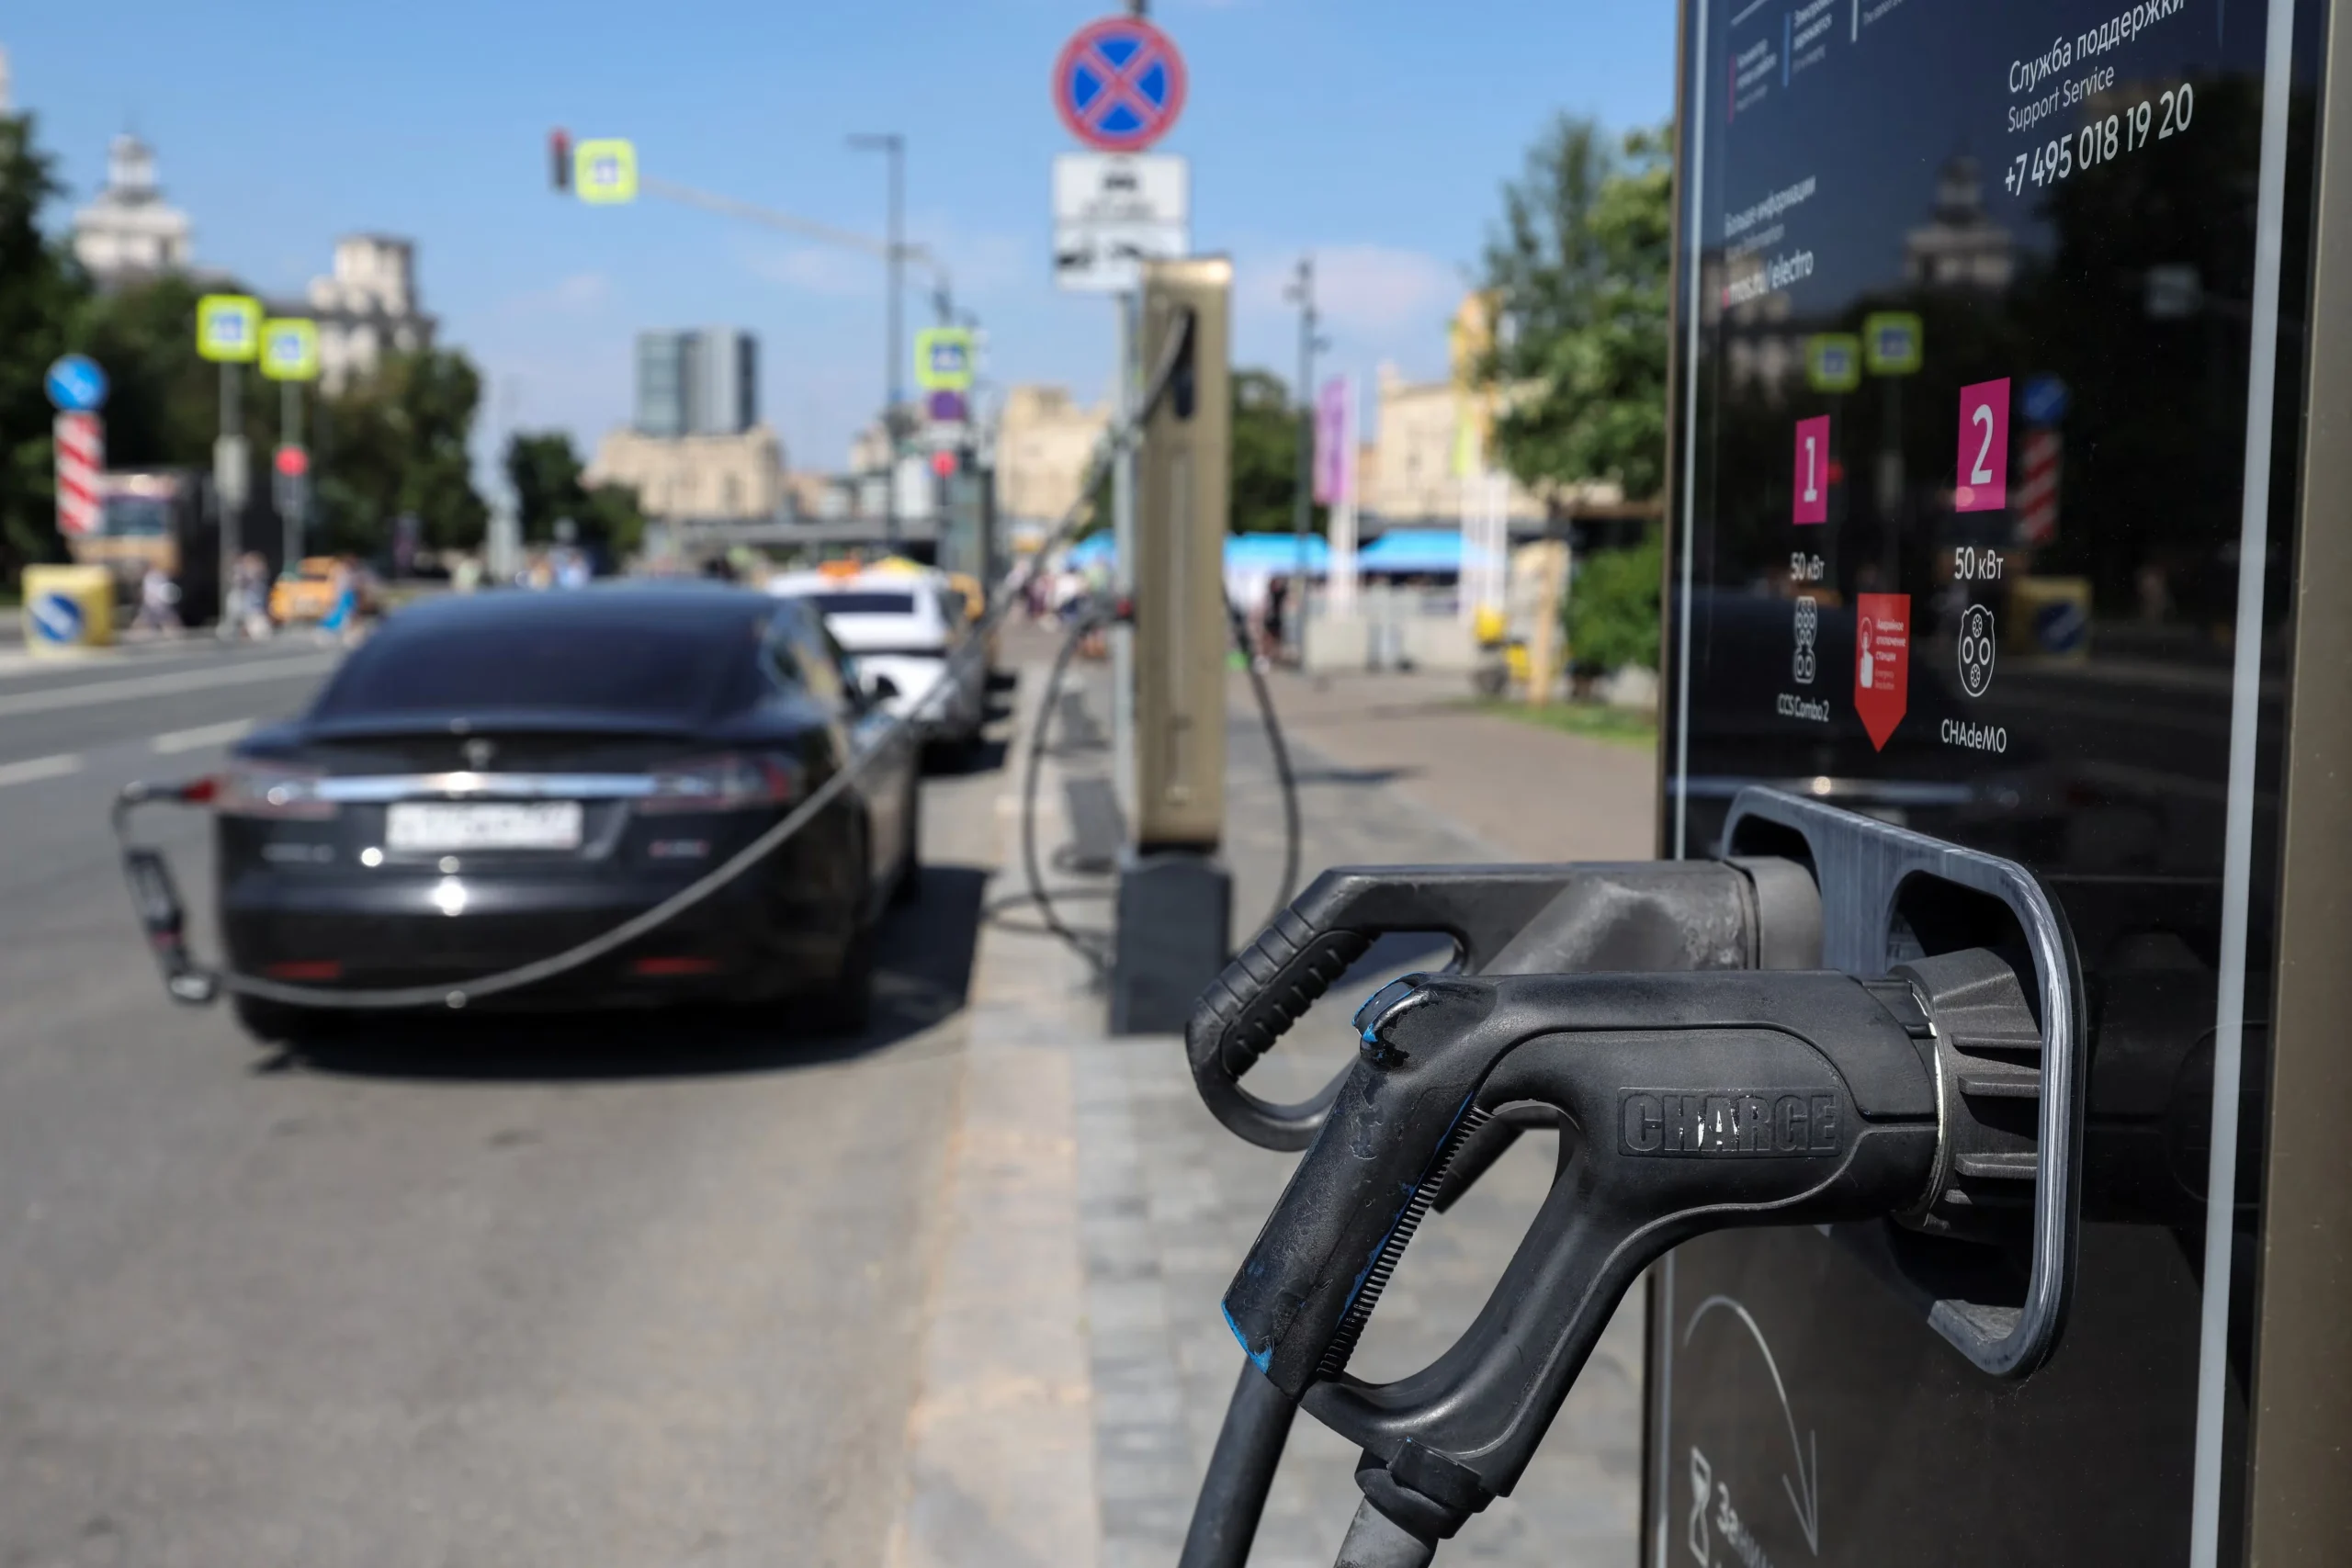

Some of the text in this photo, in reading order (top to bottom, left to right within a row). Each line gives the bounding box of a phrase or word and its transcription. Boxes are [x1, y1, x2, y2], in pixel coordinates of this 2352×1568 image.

[2009, 37, 2072, 93] Служба
[2007, 66, 2115, 132] Support Service
[2005, 83, 2194, 197] +7 495 018 19 20
[1804, 436, 1818, 502] 1
[1971, 403, 1994, 485] 2
[1790, 551, 1806, 581] 50
[1954, 546, 2004, 580] 50 кВт
[1777, 693, 1794, 716] CCS
[1941, 718, 2007, 753] CHAdeMO
[1623, 1094, 1836, 1152] CHARGE
